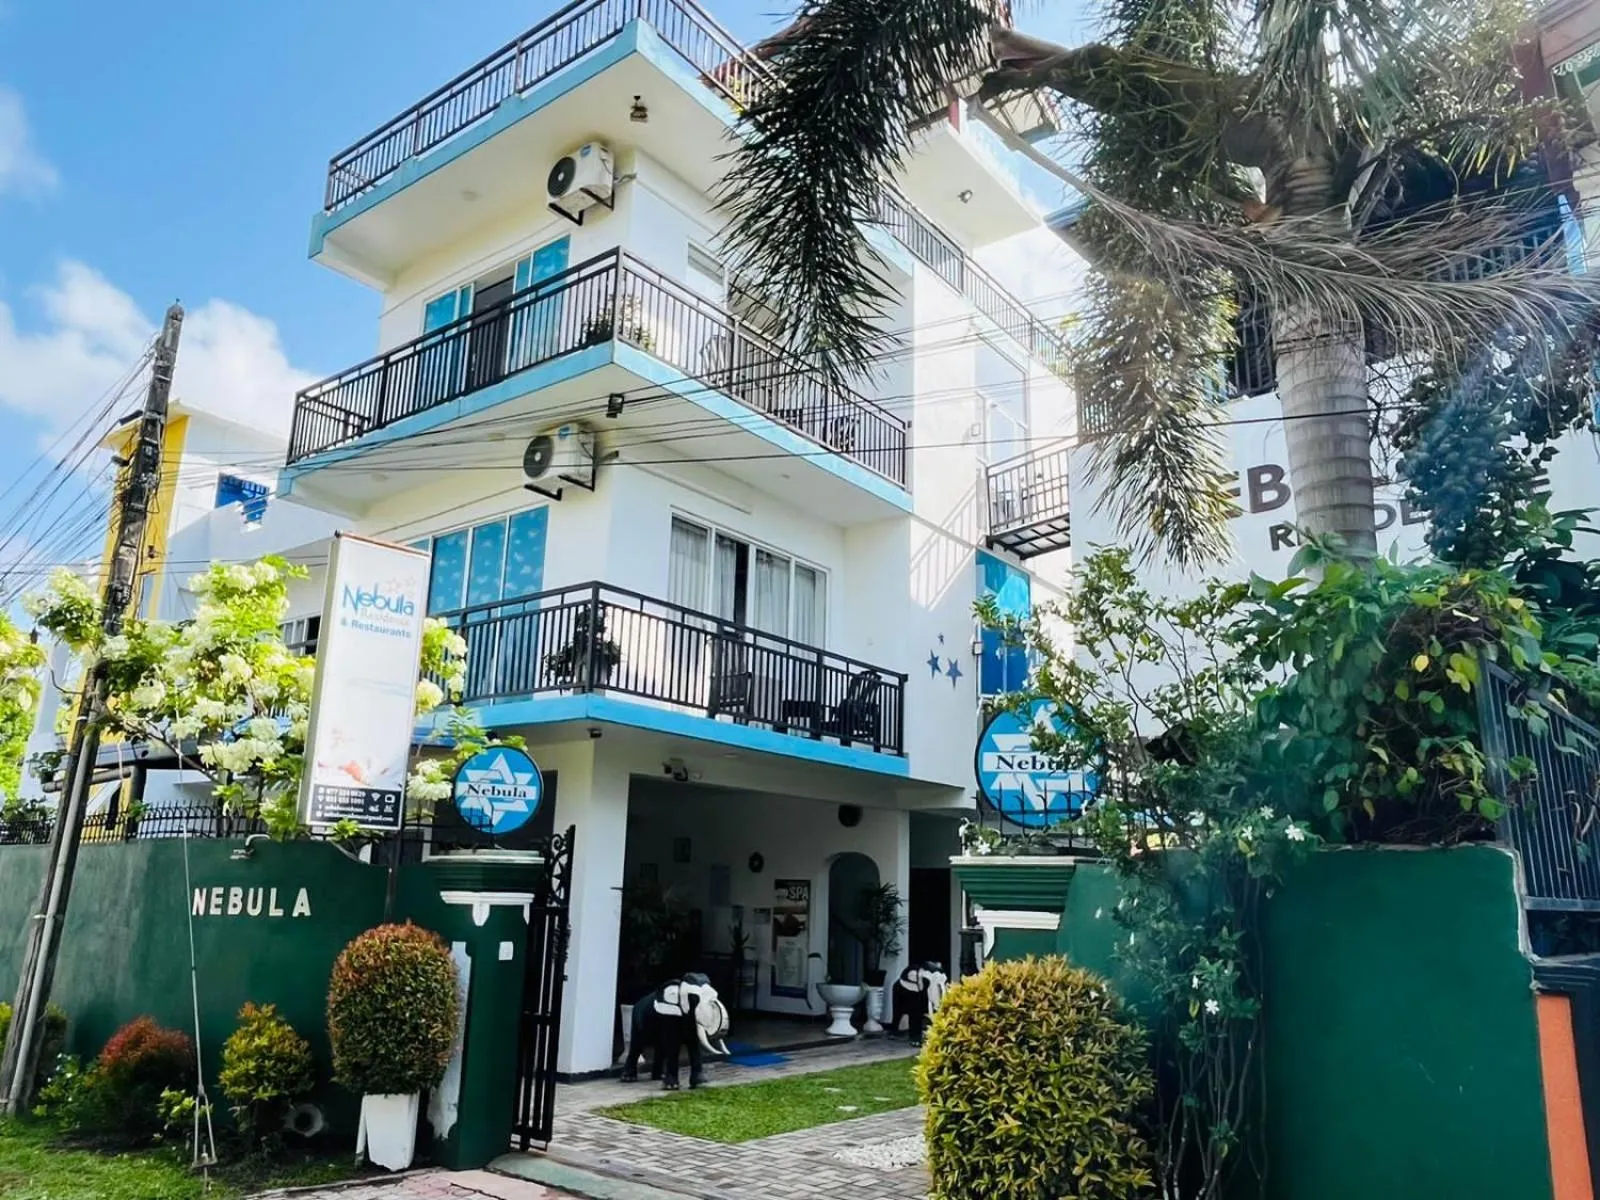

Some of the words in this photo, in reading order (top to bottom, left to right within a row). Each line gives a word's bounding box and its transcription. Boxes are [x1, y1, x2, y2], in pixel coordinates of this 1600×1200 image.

[342, 583, 415, 616] Nebula
[351, 619, 411, 638] Restaurants
[467, 783, 527, 798] Nebula
[192, 886, 311, 917] NEBULA
[790, 886, 809, 900] SPA
